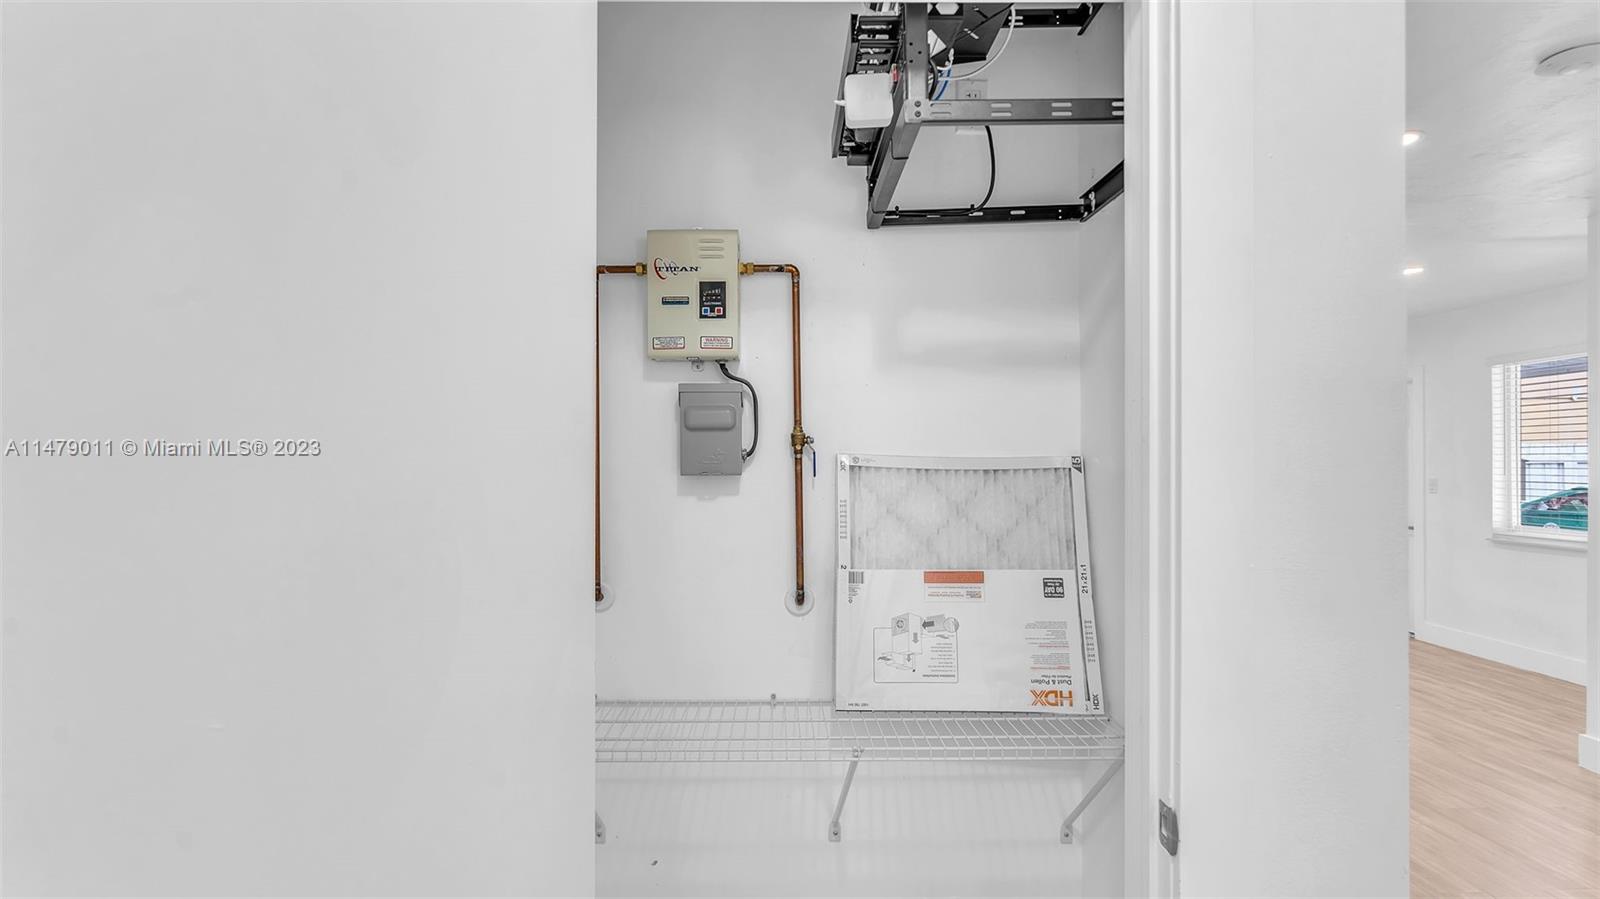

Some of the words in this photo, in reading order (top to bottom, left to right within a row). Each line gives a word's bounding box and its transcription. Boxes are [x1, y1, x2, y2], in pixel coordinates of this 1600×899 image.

[1080, 564, 1089, 594] 21x21x1
[1030, 689, 1073, 707] HDX
[1092, 694, 1100, 711] HDX
